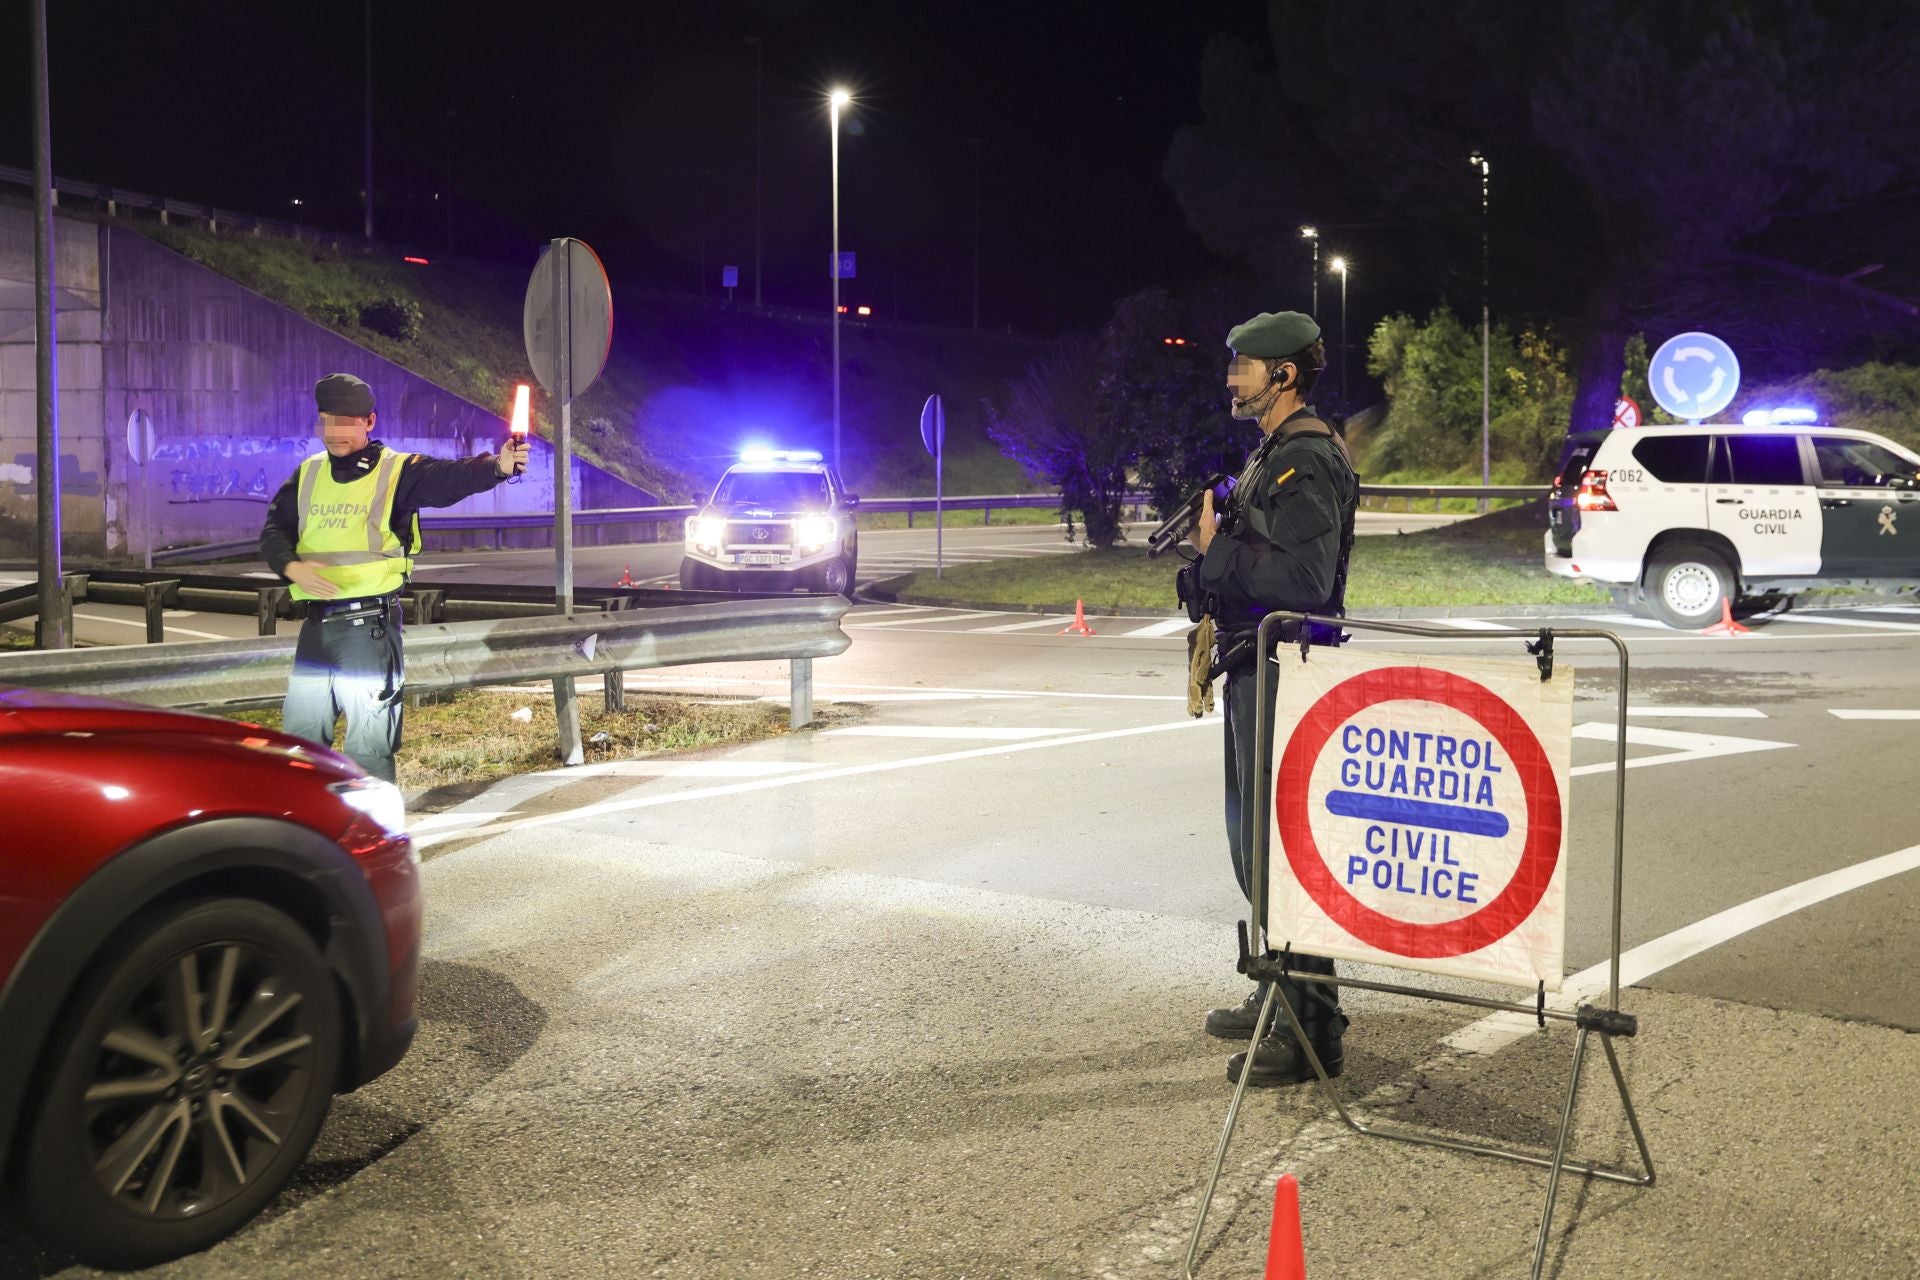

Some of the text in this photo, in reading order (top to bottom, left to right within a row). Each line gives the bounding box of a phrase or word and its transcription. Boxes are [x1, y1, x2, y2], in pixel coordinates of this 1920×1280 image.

[1619, 469, 1643, 483] 062
[310, 503, 368, 516] GUARDIA
[1739, 508, 1802, 520] GUARDIA
[1754, 523, 1787, 534] CIVIL
[1342, 725, 1502, 773] CONTROL
[1341, 758, 1494, 807] GUARDIA
[1365, 825, 1460, 866] CIVIL
[1347, 855, 1479, 904] POLICE
